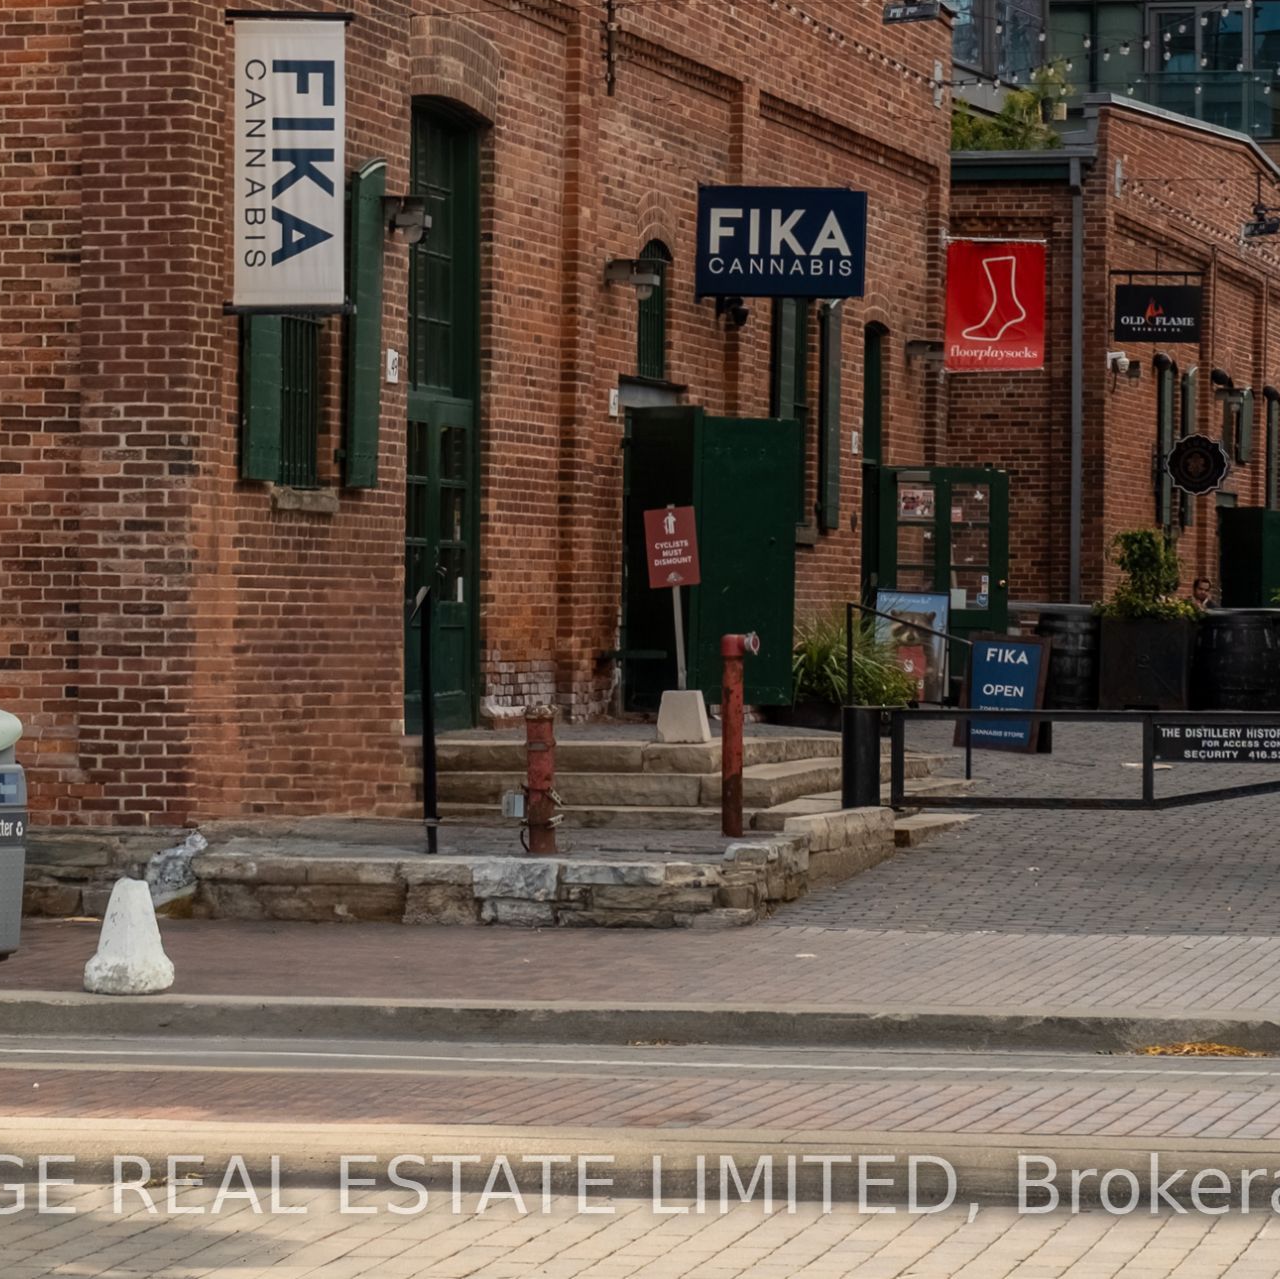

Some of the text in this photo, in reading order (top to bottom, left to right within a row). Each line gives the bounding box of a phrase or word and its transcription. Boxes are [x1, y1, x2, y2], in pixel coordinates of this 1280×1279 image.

[244, 59, 267, 268] CANNABIS
[271, 59, 336, 267] FIKA
[709, 208, 852, 256] FIKA
[708, 257, 852, 276] CANNABIS
[1120, 316, 1195, 326] OLD FLAME
[950, 344, 1038, 360] floorplaysocks
[654, 539, 689, 550] CYCLISTS
[662, 548, 682, 557] MUST
[654, 555, 692, 567] DISMOUNT
[985, 647, 1029, 665] FIKA
[982, 683, 1024, 698] OPEN
[1161, 728, 1181, 738] THE
[1185, 728, 1242, 738] DISTILLERY
[1223, 740, 1259, 748] ACCESS
[1184, 750, 1239, 759] SECURITY
